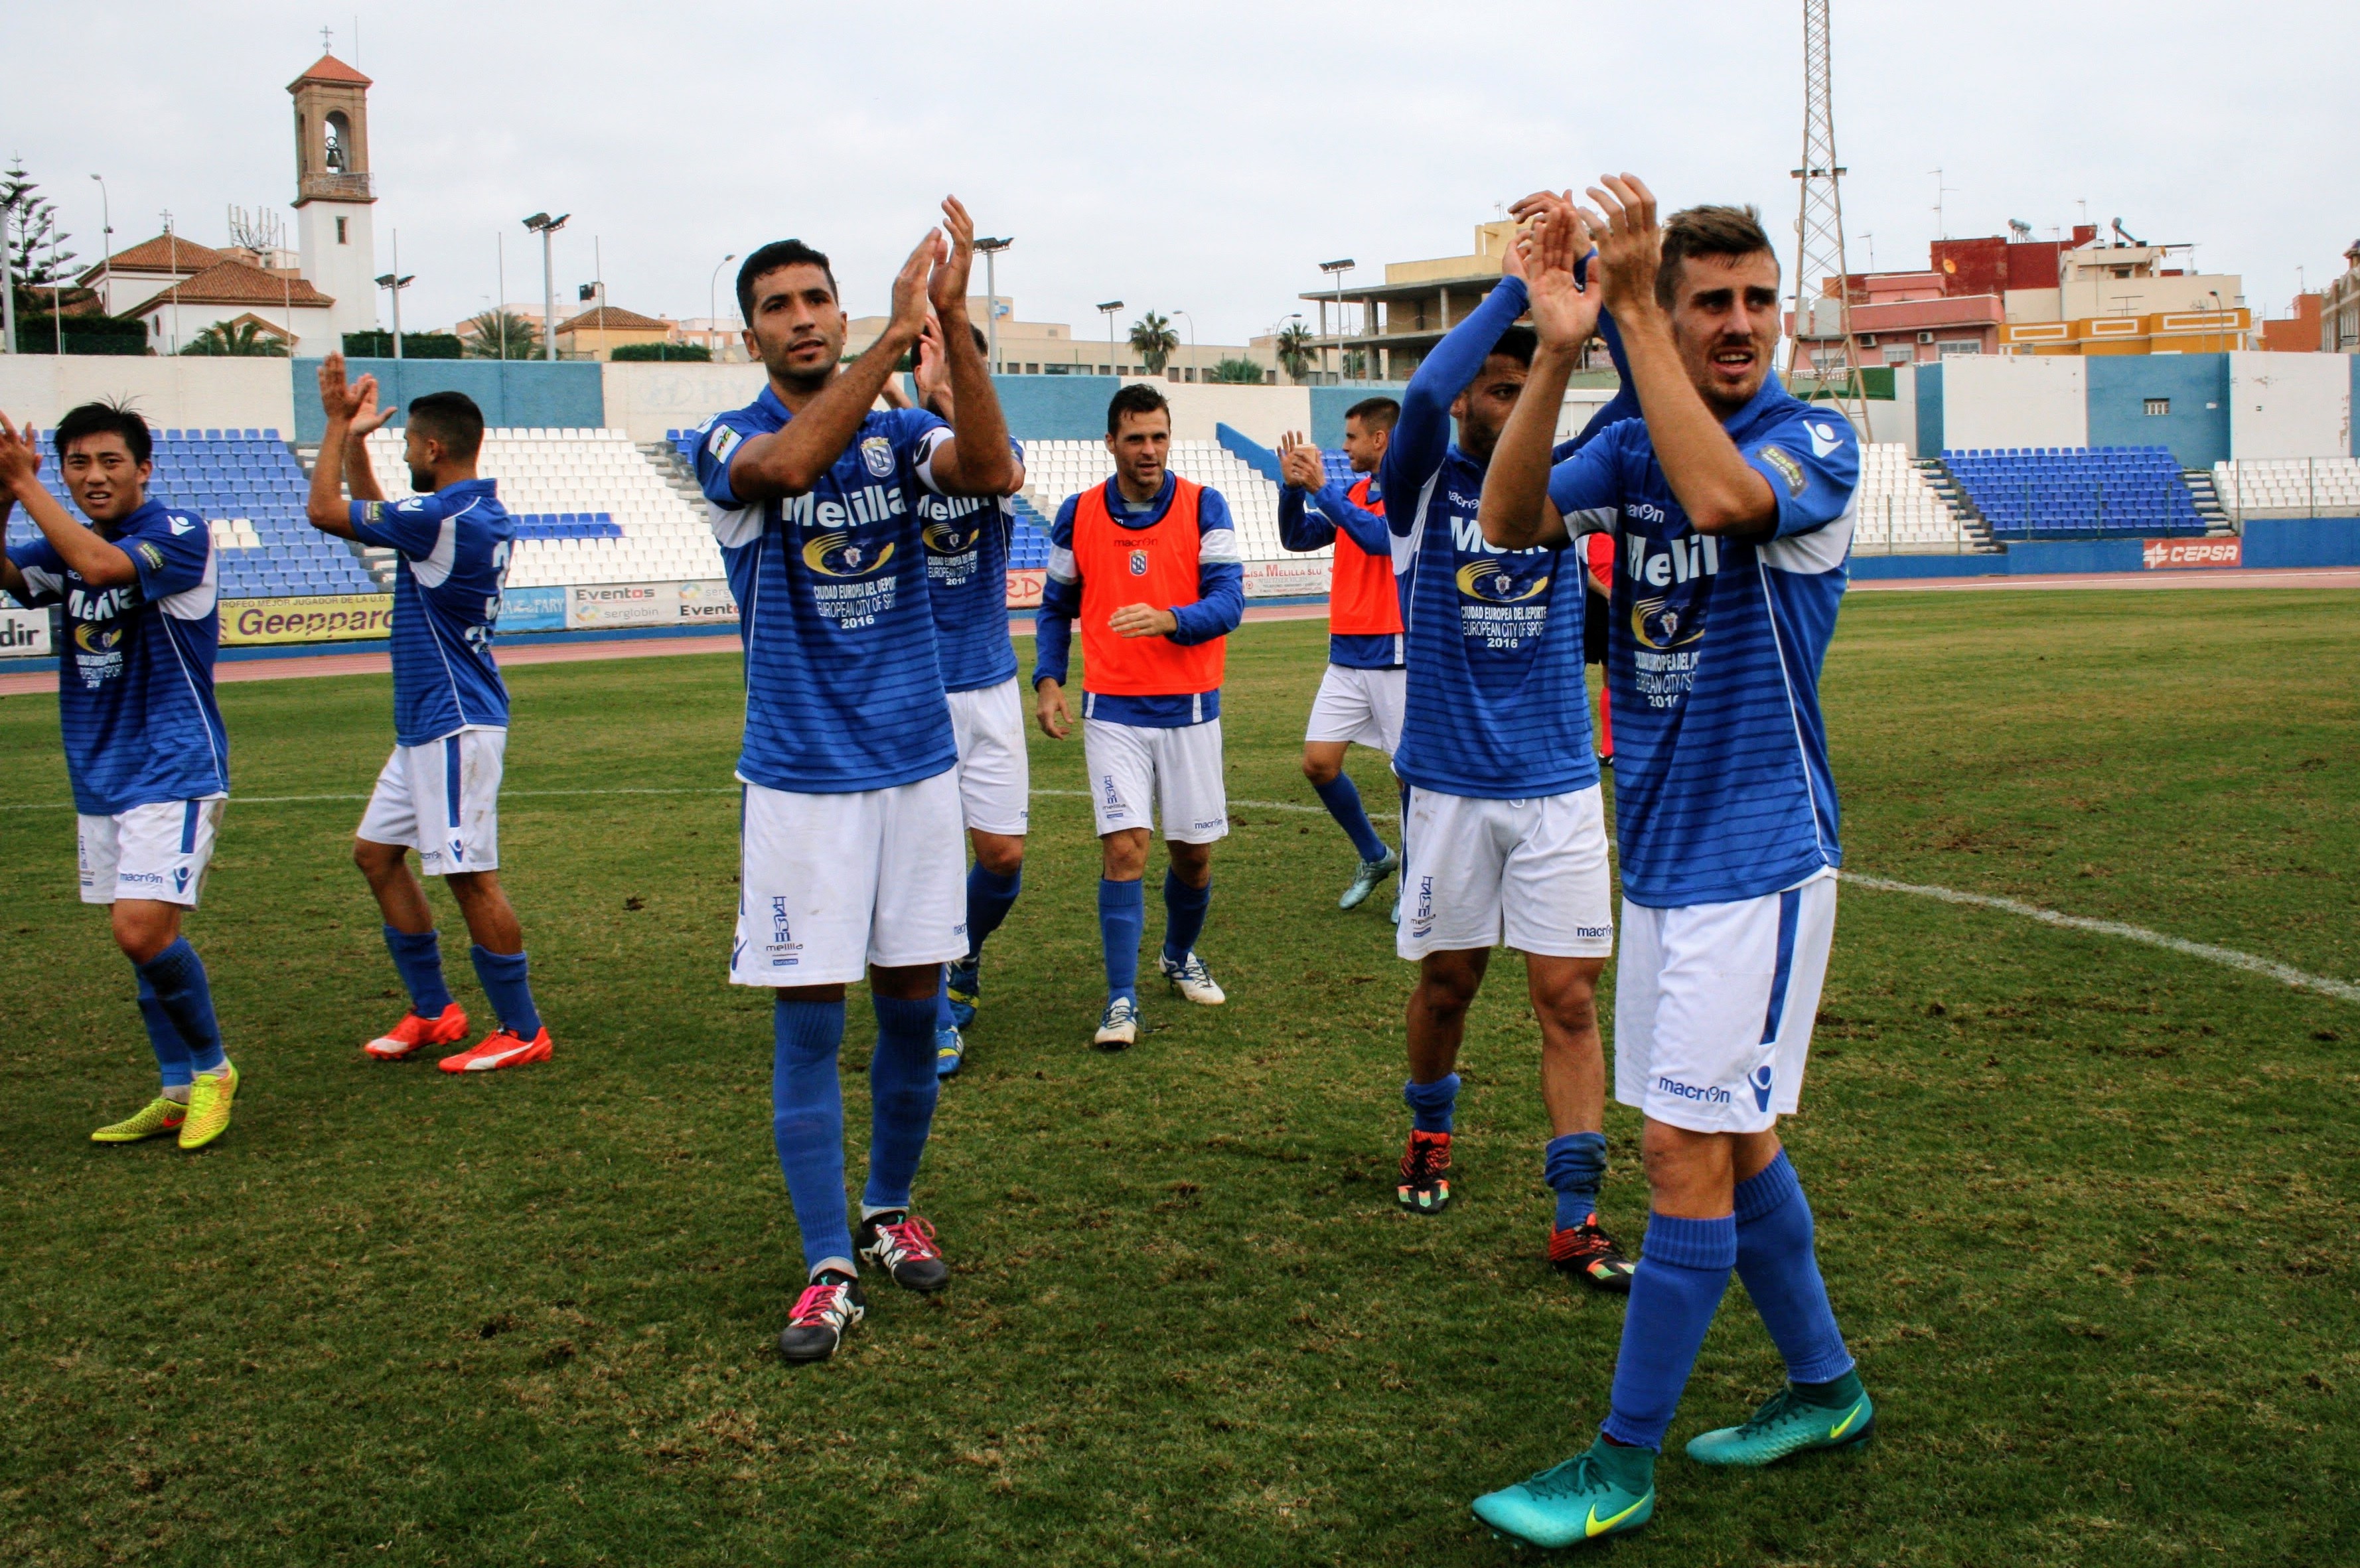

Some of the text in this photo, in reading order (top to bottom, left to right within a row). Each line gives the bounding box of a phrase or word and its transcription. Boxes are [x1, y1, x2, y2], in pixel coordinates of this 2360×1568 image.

[782, 485, 907, 528] Melilla
[2170, 545, 2238, 562] CEPSA
[1266, 564, 1305, 577] MELILLA
[576, 587, 655, 601] Eventos
[814, 583, 838, 601] CIUDAD
[838, 581, 864, 600] EUROPEA
[865, 580, 877, 597] DEL
[293, 597, 340, 606] JUGADOR
[817, 601, 855, 618] EUROPEAN
[855, 598, 871, 617] CITY
[871, 596, 883, 612] OF
[604, 608, 658, 620] serglobin
[1461, 606, 1484, 619] CIUDAD
[1485, 607, 1513, 620] EUROPEA
[1513, 606, 1525, 620] DEL
[842, 615, 875, 629] 2016
[1463, 622, 1501, 637] EUROPEAN
[1501, 622, 1518, 638] CITY
[1518, 622, 1527, 638] OF
[1487, 638, 1518, 648] 2016
[120, 873, 163, 884] macron
[766, 943, 804, 952] melilla
[1659, 1076, 1731, 1104] macron
